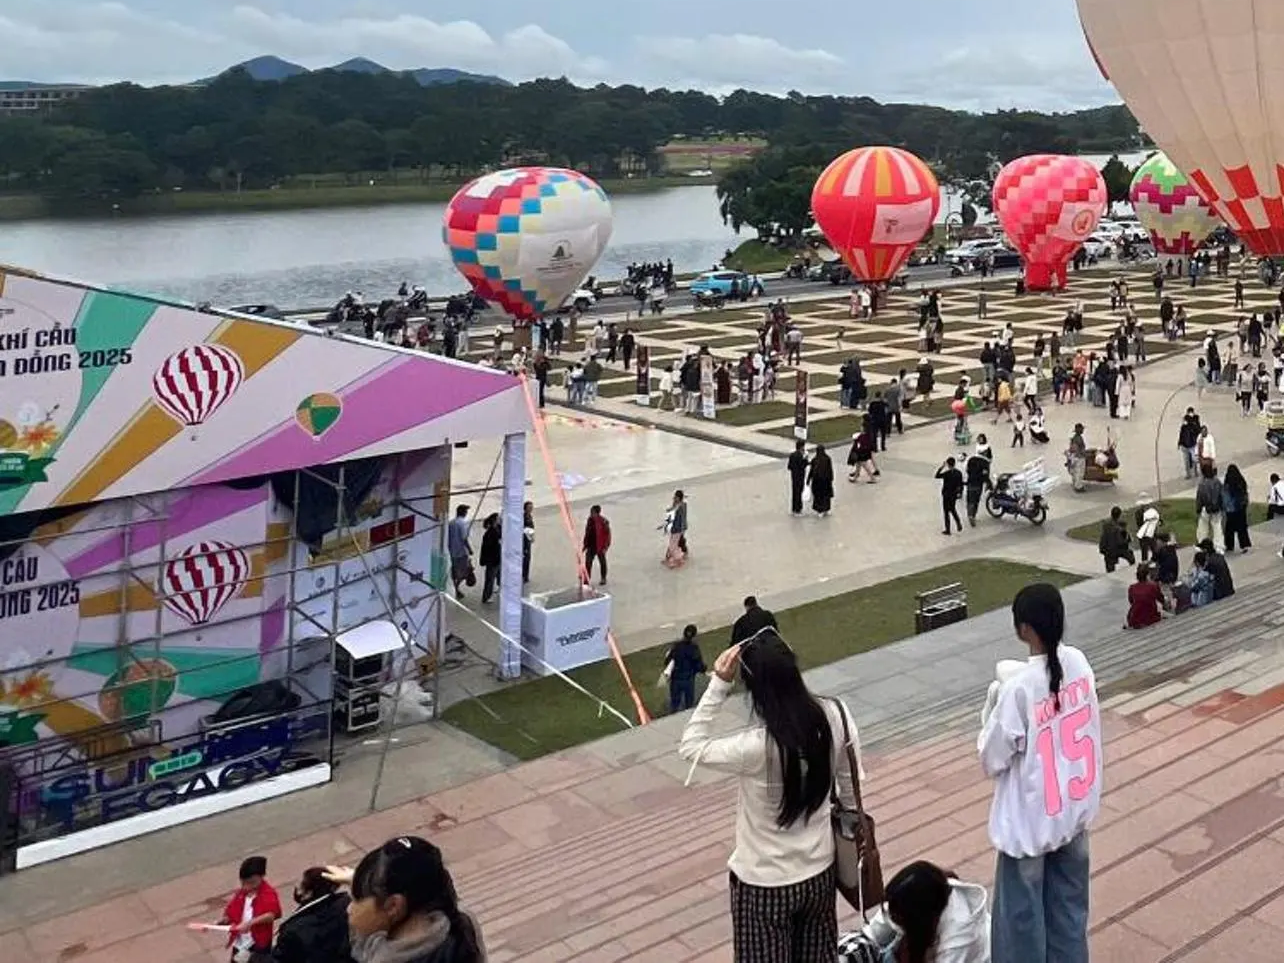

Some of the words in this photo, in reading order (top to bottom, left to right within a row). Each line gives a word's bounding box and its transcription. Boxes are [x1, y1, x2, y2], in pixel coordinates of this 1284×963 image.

[35, 321, 77, 348] CẦU
[78, 347, 132, 369] 2025
[37, 580, 80, 612] 2025
[1036, 703, 1096, 817] 15
